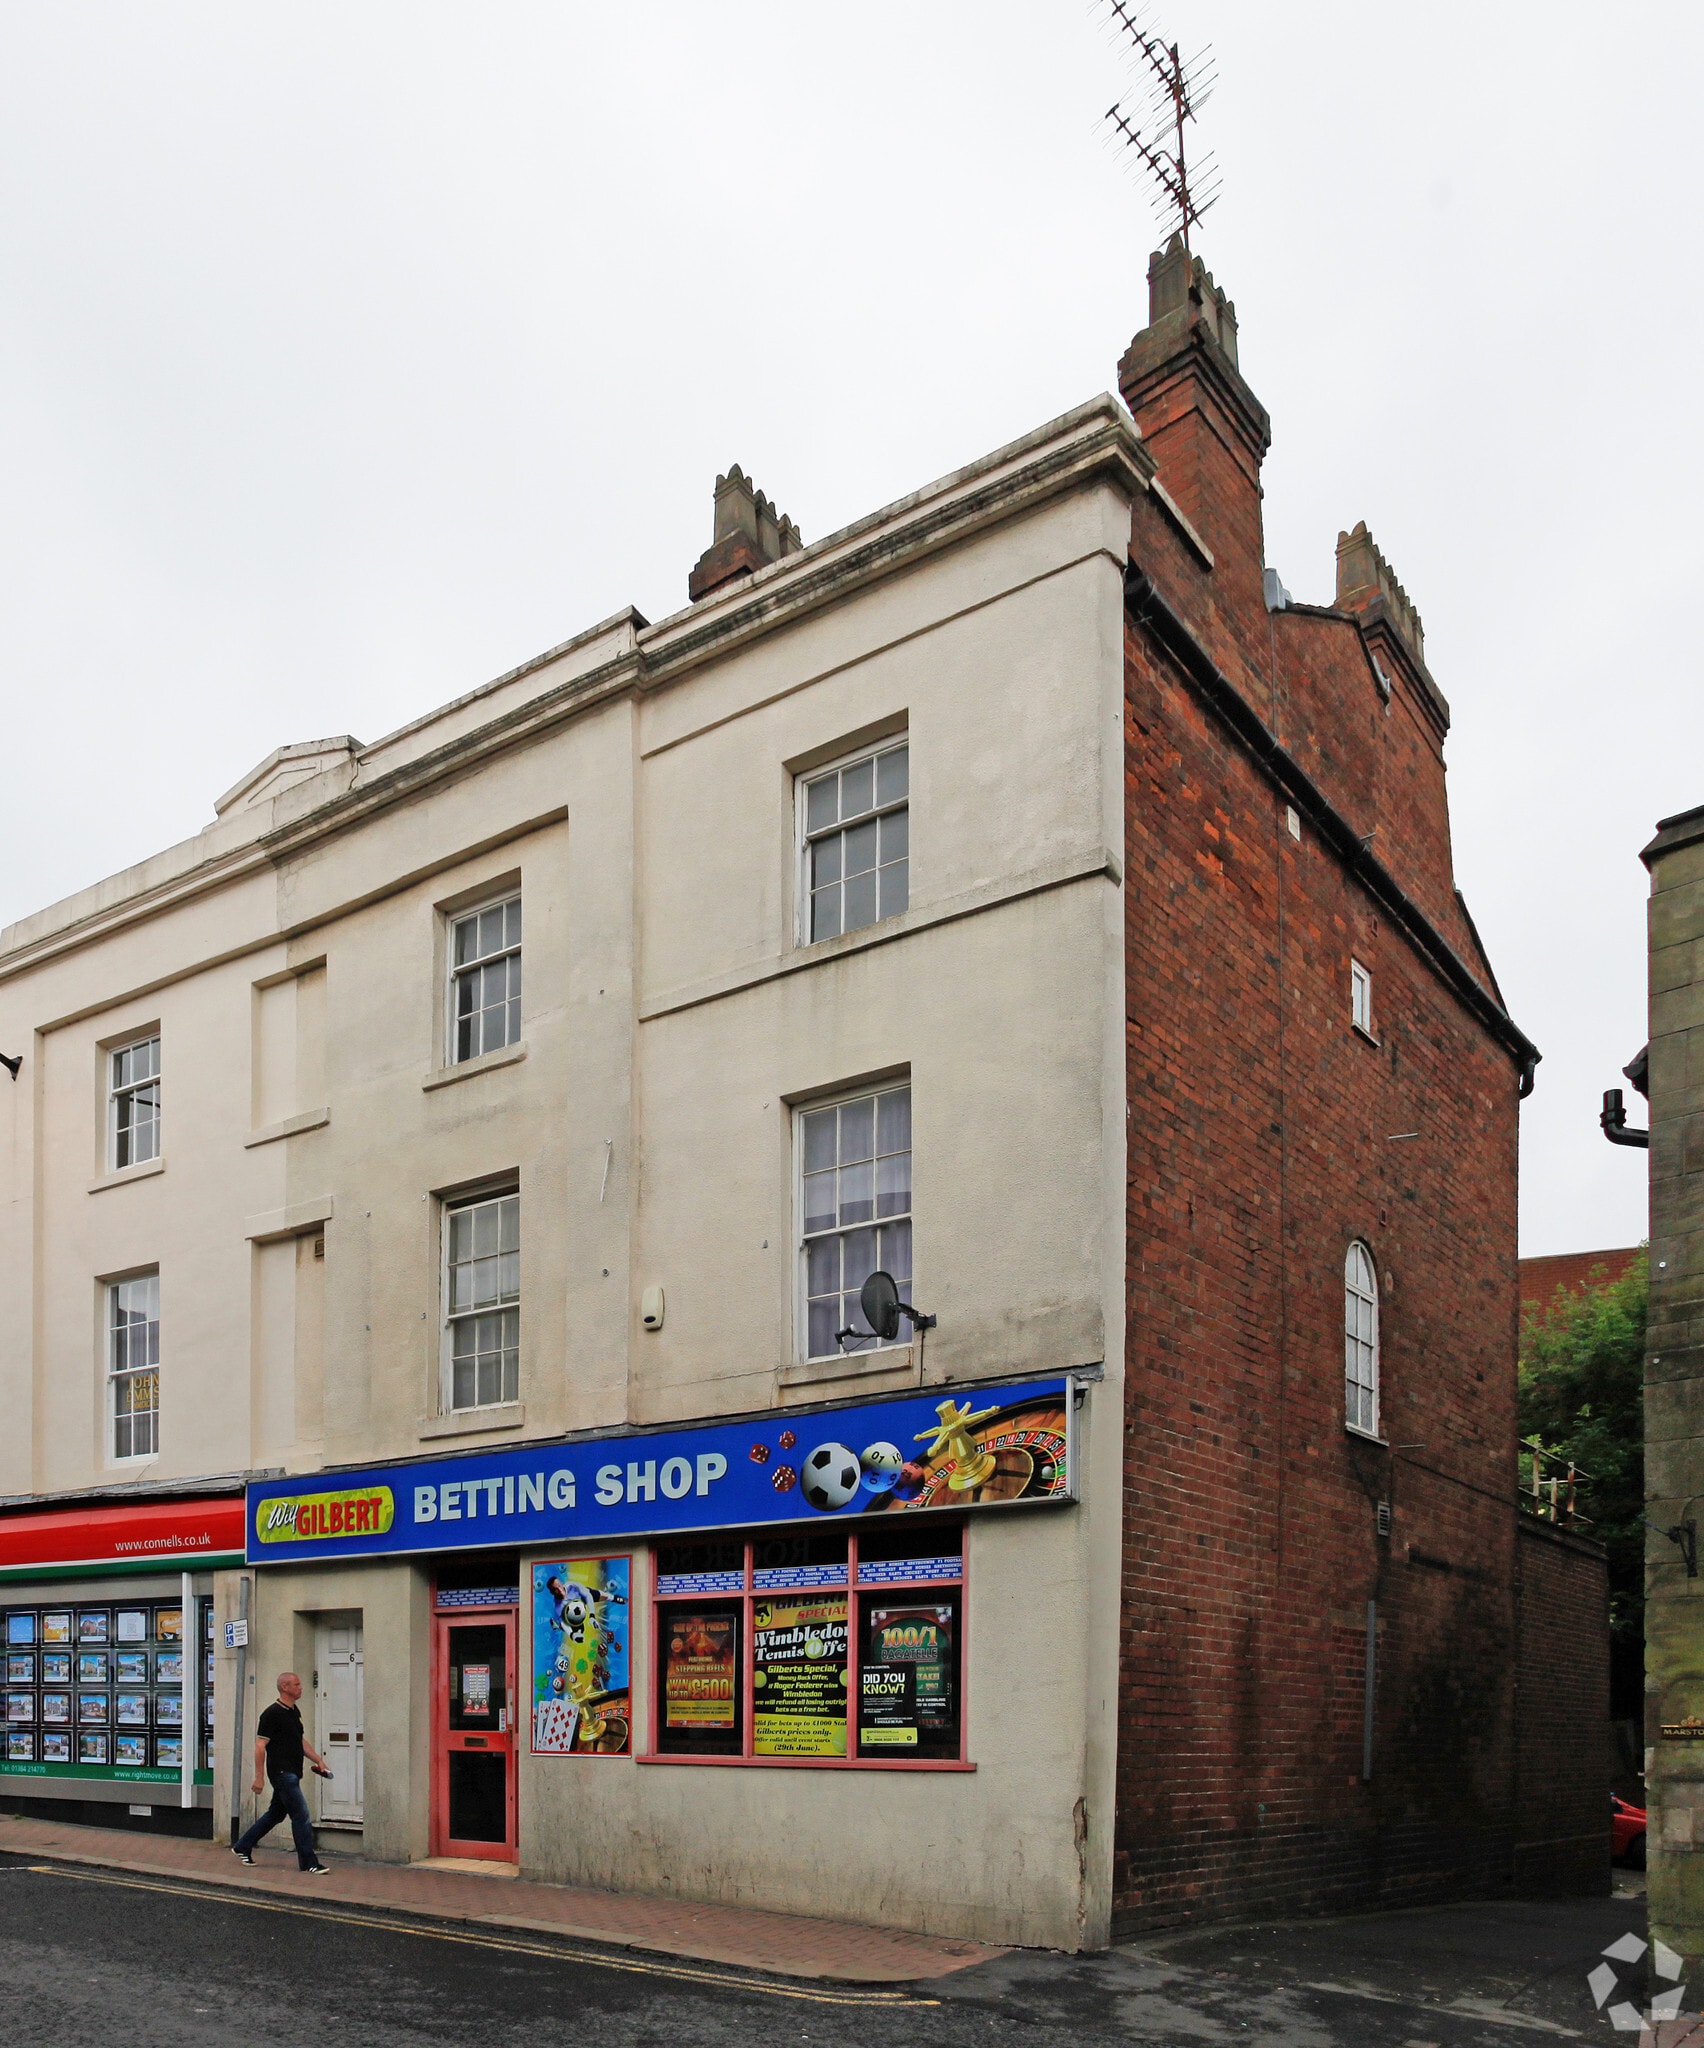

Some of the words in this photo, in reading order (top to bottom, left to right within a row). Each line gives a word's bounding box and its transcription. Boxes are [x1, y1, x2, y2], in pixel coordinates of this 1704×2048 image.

[988, 1440, 993, 1449] 9
[996, 1436, 1005, 1446] 22
[414, 1468, 576, 1523] BETTING
[594, 1452, 727, 1506] SHOP
[267, 1501, 299, 1533] Wilf
[297, 1497, 383, 1535] GILBERT
[115, 1532, 211, 1551] www.connells.co.uk
[776, 1593, 848, 1610] GILBERT
[226, 1624, 232, 1634] P
[881, 1626, 938, 1648] 100/1
[754, 1645, 805, 1661] Tennis
[807, 1640, 846, 1658] Offe
[881, 1647, 938, 1660] BAGATELLE
[349, 1653, 355, 1662] 6
[559, 1660, 569, 1670] 49
[675, 1664, 705, 1673] STEPPING
[706, 1664, 725, 1672] REELS
[767, 1665, 803, 1673] Gilberts
[804, 1664, 838, 1674] Special,
[863, 1673, 880, 1684] DID
[883, 1672, 905, 1683] YOU
[669, 1679, 689, 1690] WIN
[691, 1678, 730, 1700] £500
[773, 1682, 795, 1690] Roger
[863, 1683, 905, 1694] KNOW?
[669, 1690, 678, 1699] UP
[679, 1690, 689, 1699] TO
[787, 1728, 811, 1736] prices
[812, 1728, 832, 1736] only.
[774, 1744, 794, 1752] (29th
[114, 1771, 179, 1780] www.rightmove.co.uk
